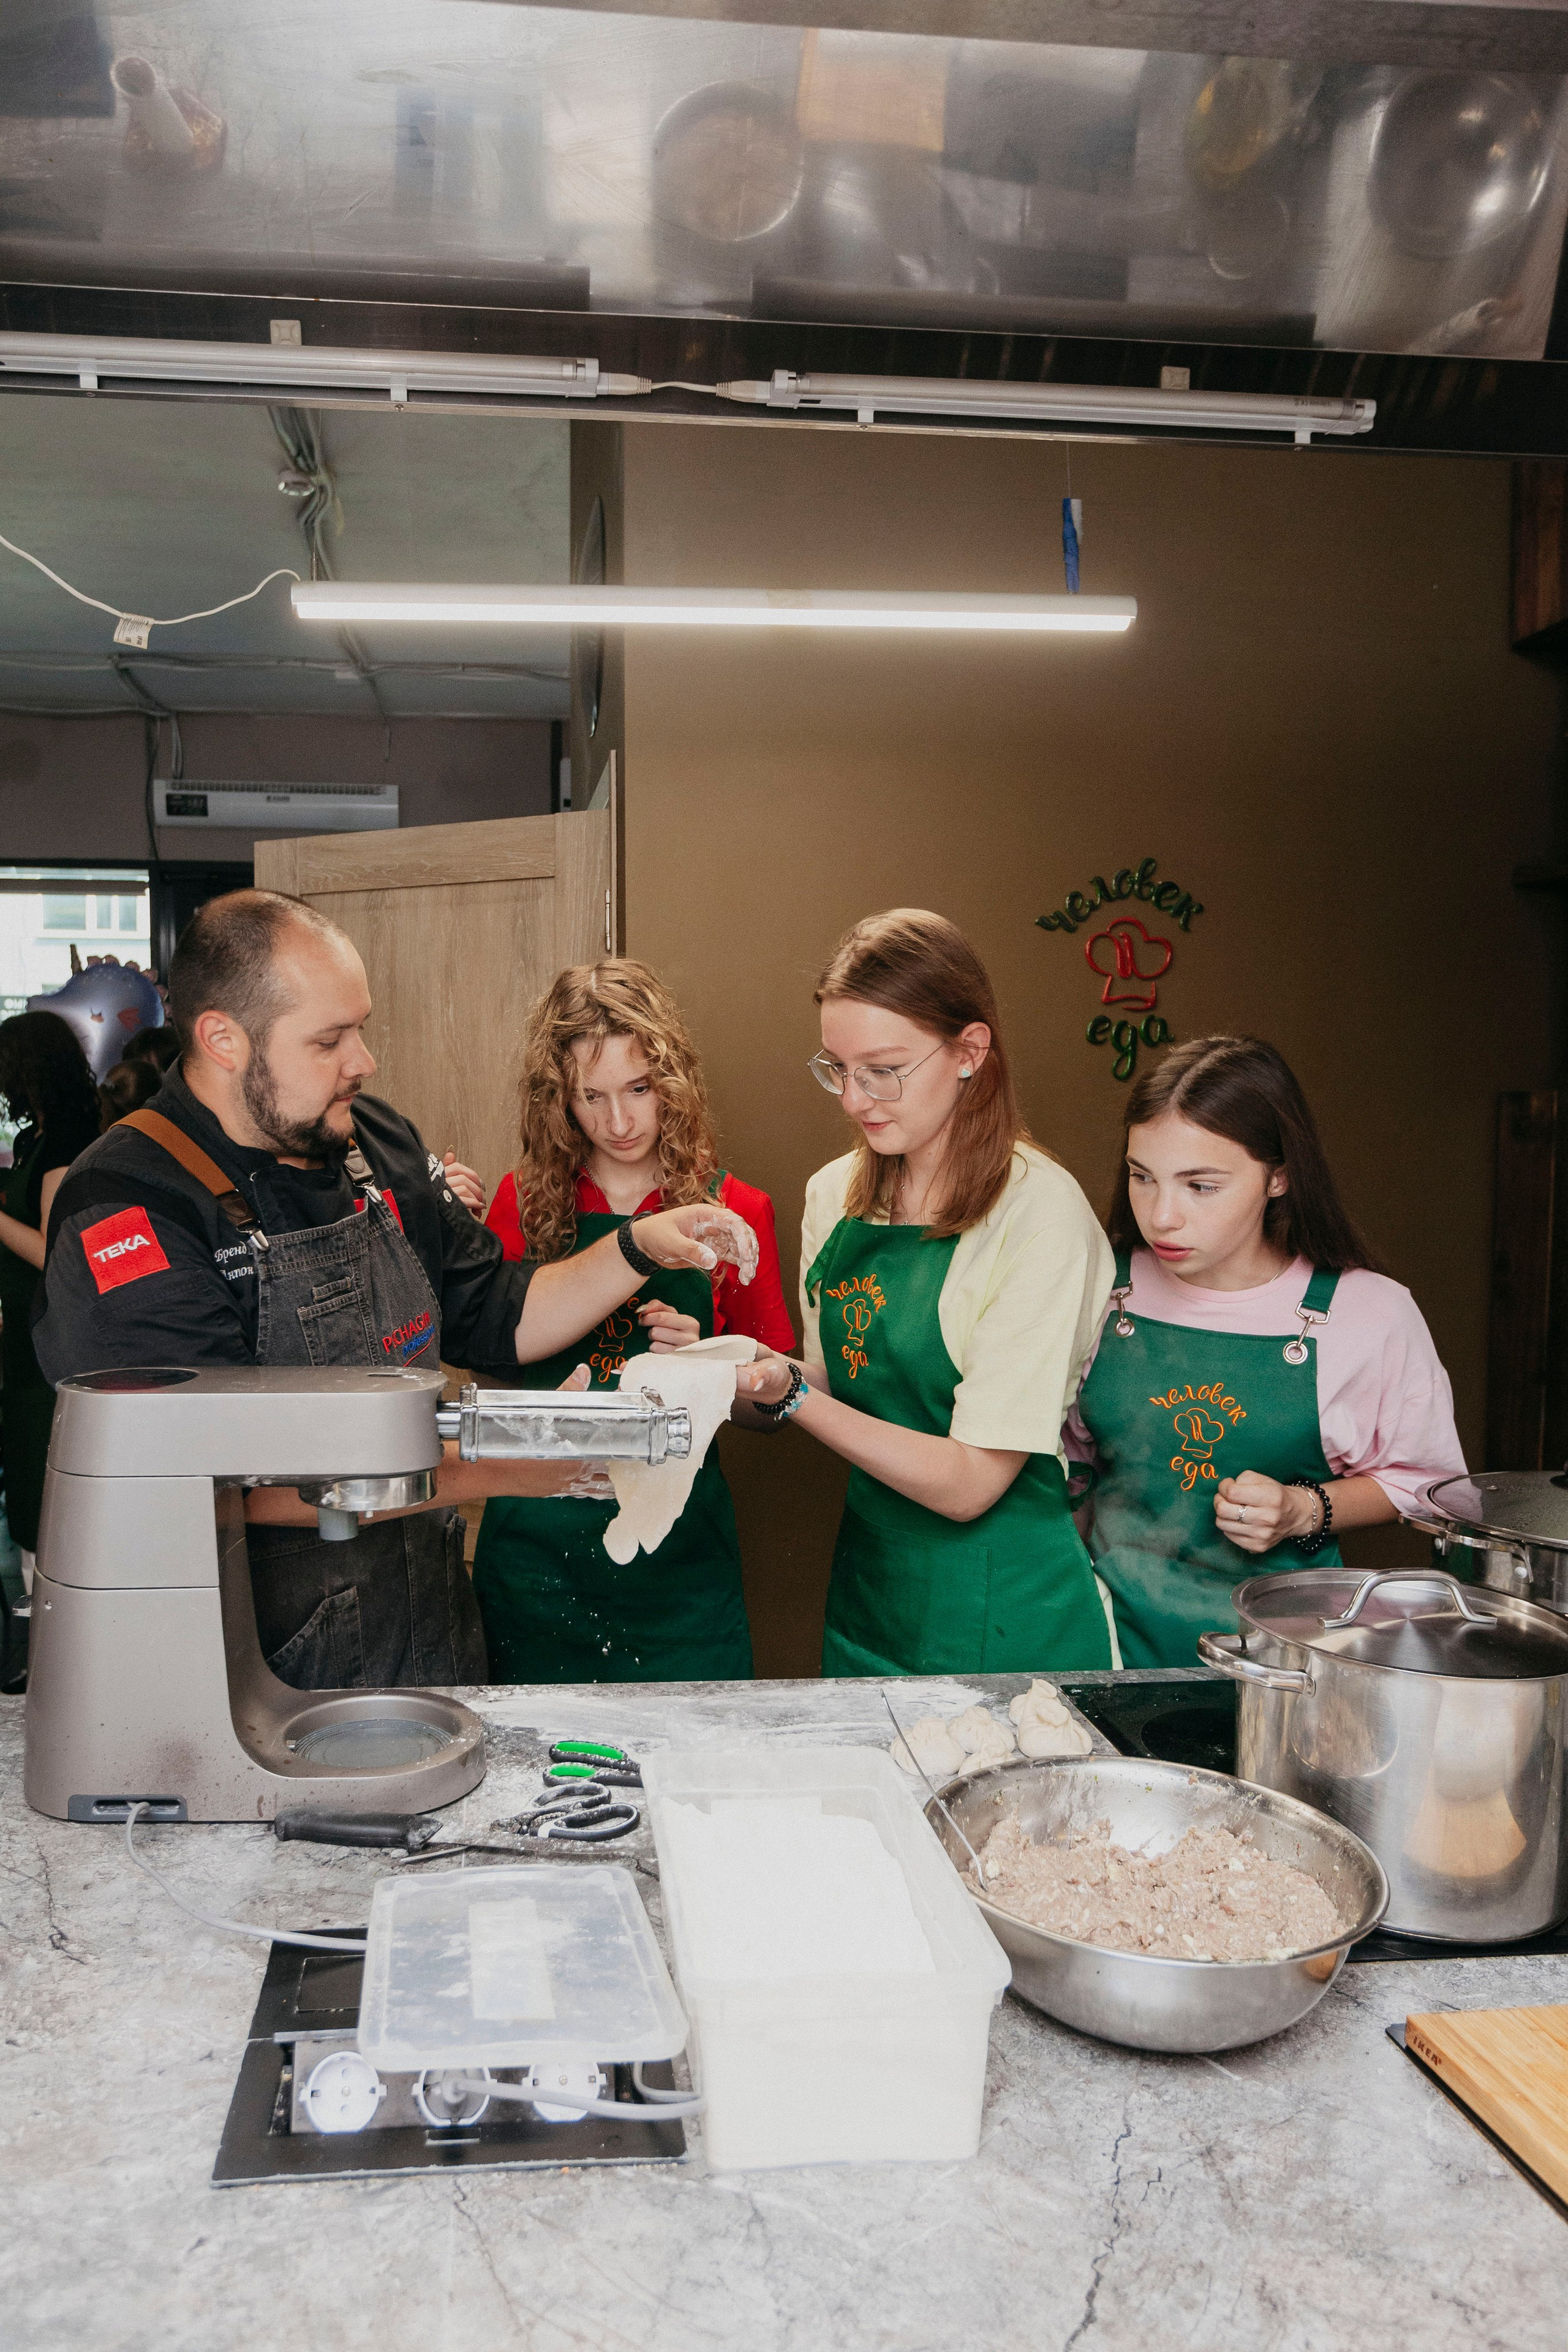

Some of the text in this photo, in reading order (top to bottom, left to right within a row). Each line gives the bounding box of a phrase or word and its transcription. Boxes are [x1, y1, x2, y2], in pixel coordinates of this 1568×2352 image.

[1035, 857, 1205, 932] человек
[93, 1234, 151, 1263] TEKA
[826, 1273, 887, 1313] человек
[1148, 1382, 1247, 1427] человек
